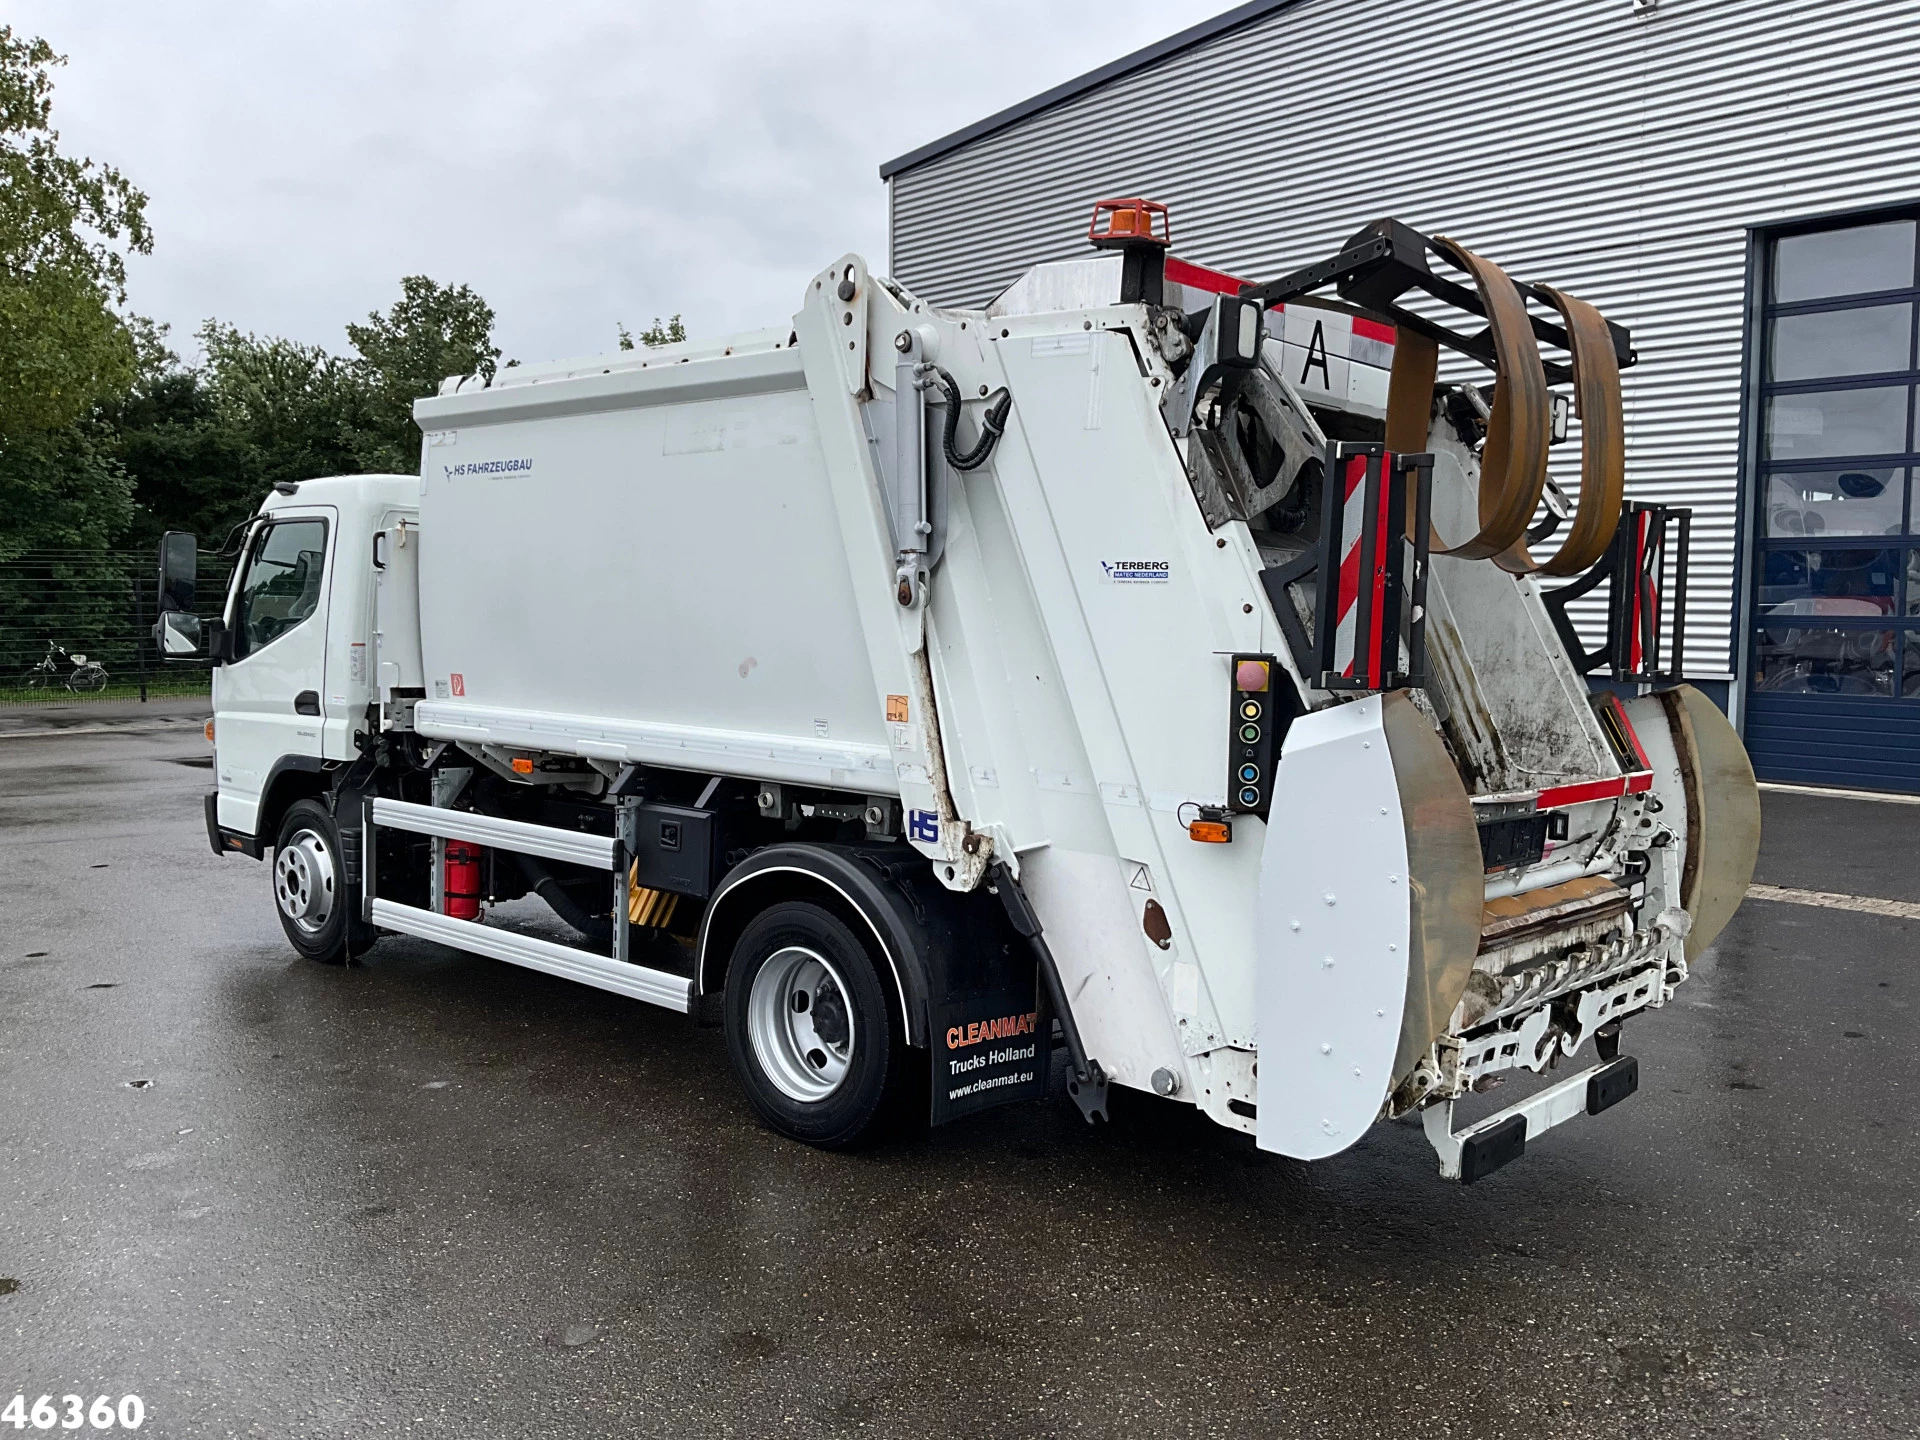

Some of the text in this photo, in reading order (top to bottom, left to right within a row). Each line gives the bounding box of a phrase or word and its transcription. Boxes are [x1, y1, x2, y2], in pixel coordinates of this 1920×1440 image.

[1300, 319, 1330, 391] A
[454, 458, 533, 476] HS FAHRZEUGBAU
[1115, 561, 1169, 570] TERBERG
[909, 810, 938, 842] HS
[946, 1013, 1037, 1050] CLEANMAT
[949, 1043, 1035, 1075] Trucks Holland
[949, 1071, 1034, 1100] www.cleanmat.eu
